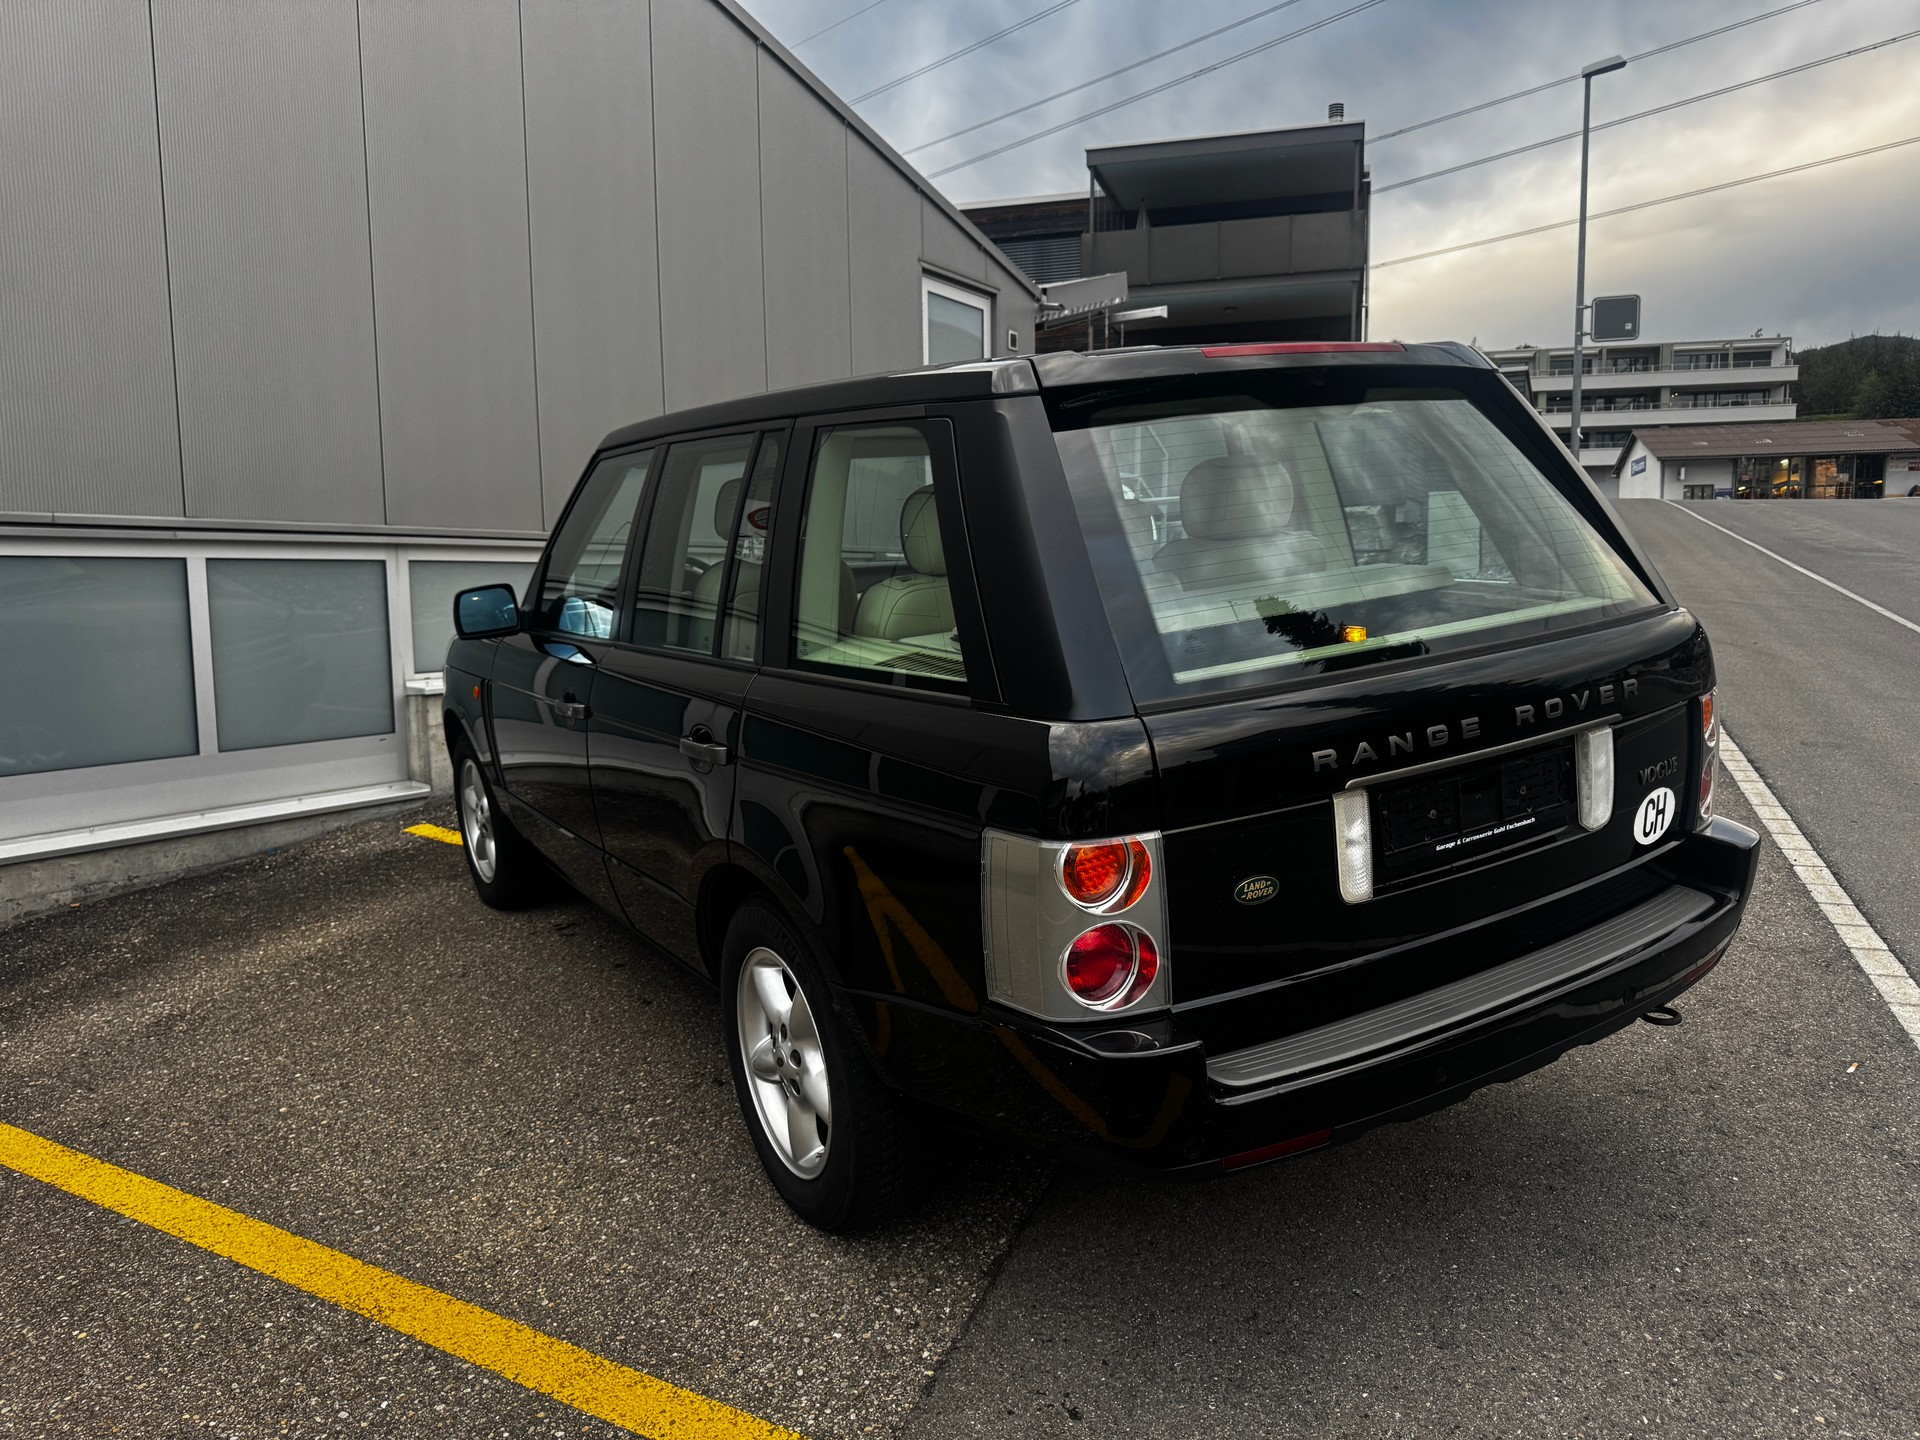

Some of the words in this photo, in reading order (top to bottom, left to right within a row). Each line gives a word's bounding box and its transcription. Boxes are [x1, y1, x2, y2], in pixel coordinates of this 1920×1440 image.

[1312, 716, 1481, 772] RANGE
[1515, 678, 1640, 727] ROVER
[1638, 756, 1678, 786] VOGUE
[1643, 791, 1667, 838] CH
[1436, 841, 1456, 851] Garage
[1243, 880, 1266, 892] LAND
[1246, 886, 1274, 900] ROVER
